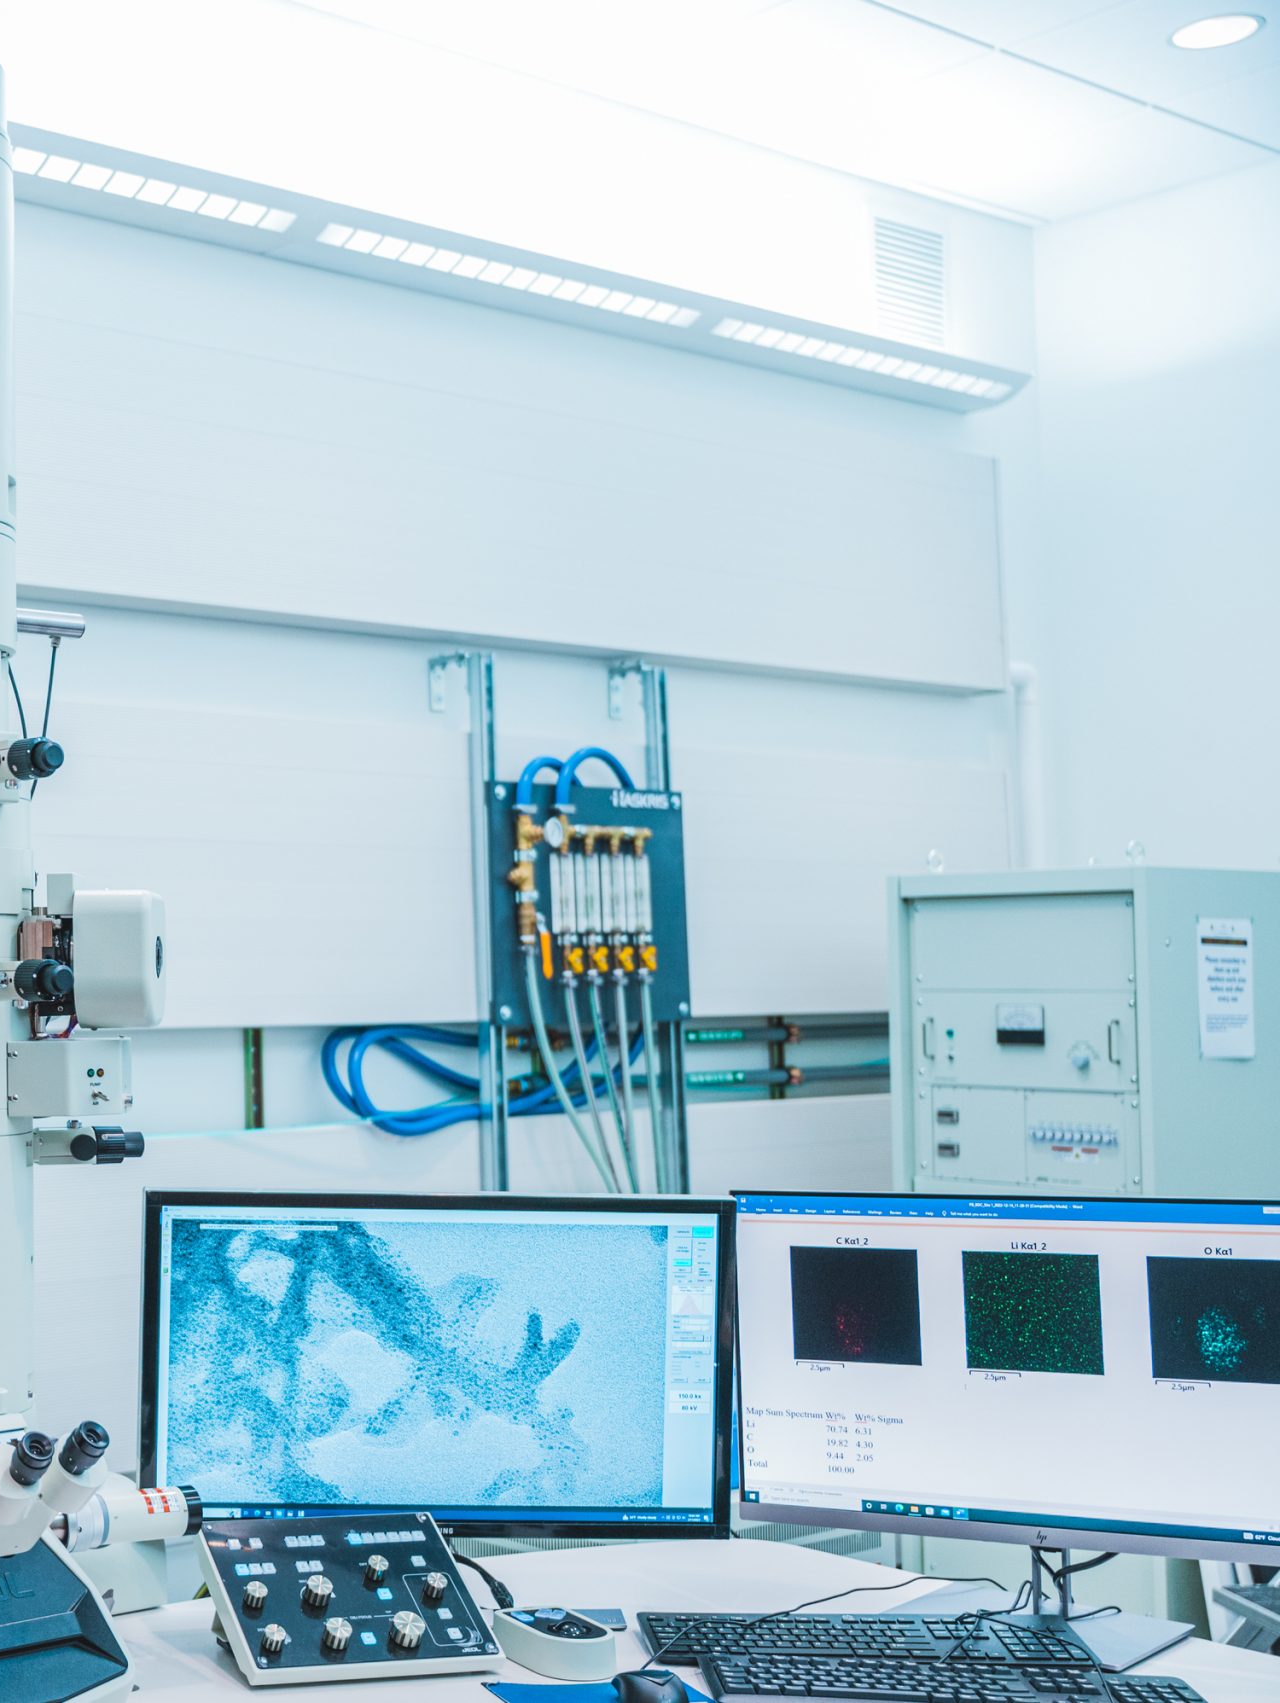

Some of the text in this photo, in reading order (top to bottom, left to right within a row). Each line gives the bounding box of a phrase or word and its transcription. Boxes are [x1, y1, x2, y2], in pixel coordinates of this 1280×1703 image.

[610, 789, 669, 809] HASKRIS
[836, 1237, 842, 1245] C
[1011, 1241, 1019, 1250] Li
[1204, 1247, 1212, 1255] O
[746, 1407, 904, 1425] Map Sum Spectrum Wt% Wt% Sigma
[746, 1419, 872, 1436] Li 70.74 6.31
[746, 1433, 874, 1449] C 19.82 4.30
[747, 1446, 874, 1462] O 9.44 2.05
[748, 1459, 855, 1474] Total 100.00
[1036, 1530, 1048, 1544] hp
